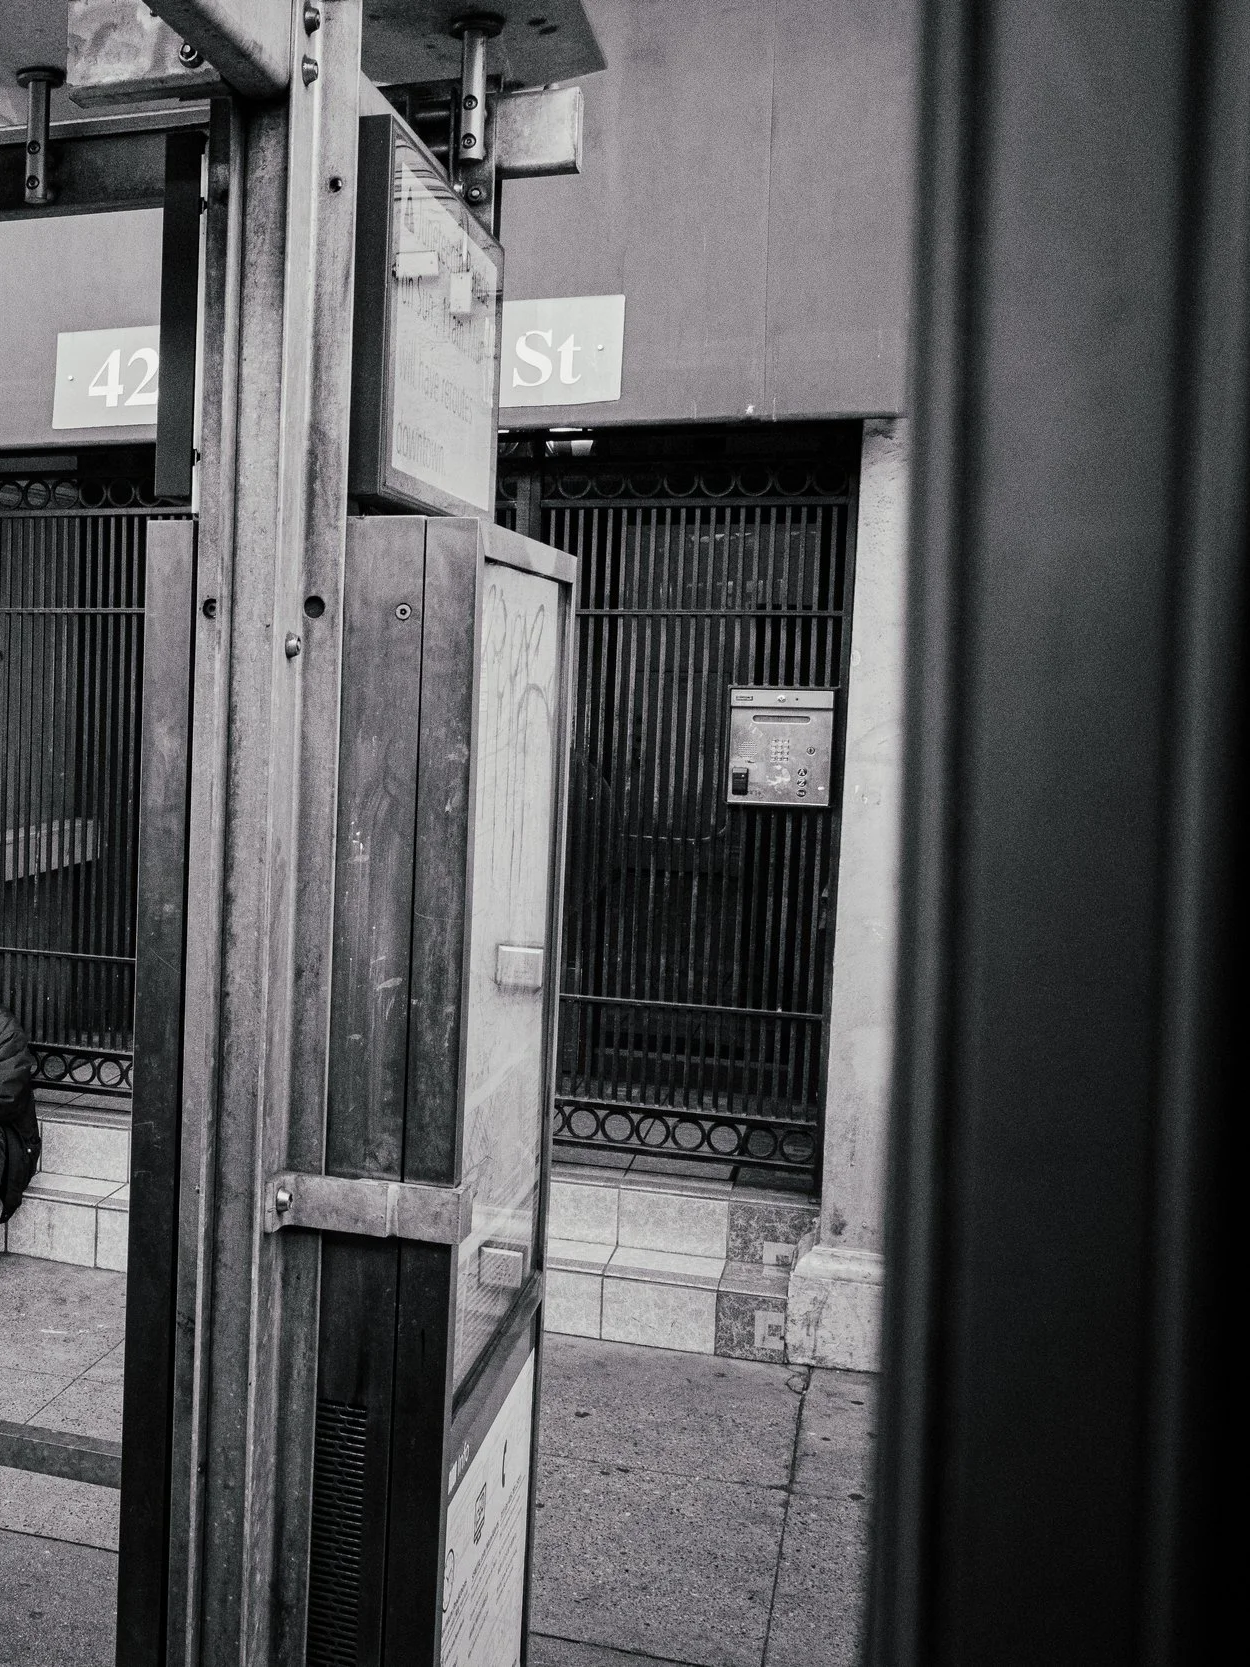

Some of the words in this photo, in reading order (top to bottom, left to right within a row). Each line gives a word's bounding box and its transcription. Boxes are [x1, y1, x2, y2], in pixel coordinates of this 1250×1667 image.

[88, 347, 160, 407] 42
[512, 329, 582, 389] St
[441, 371, 472, 426] reroutes
